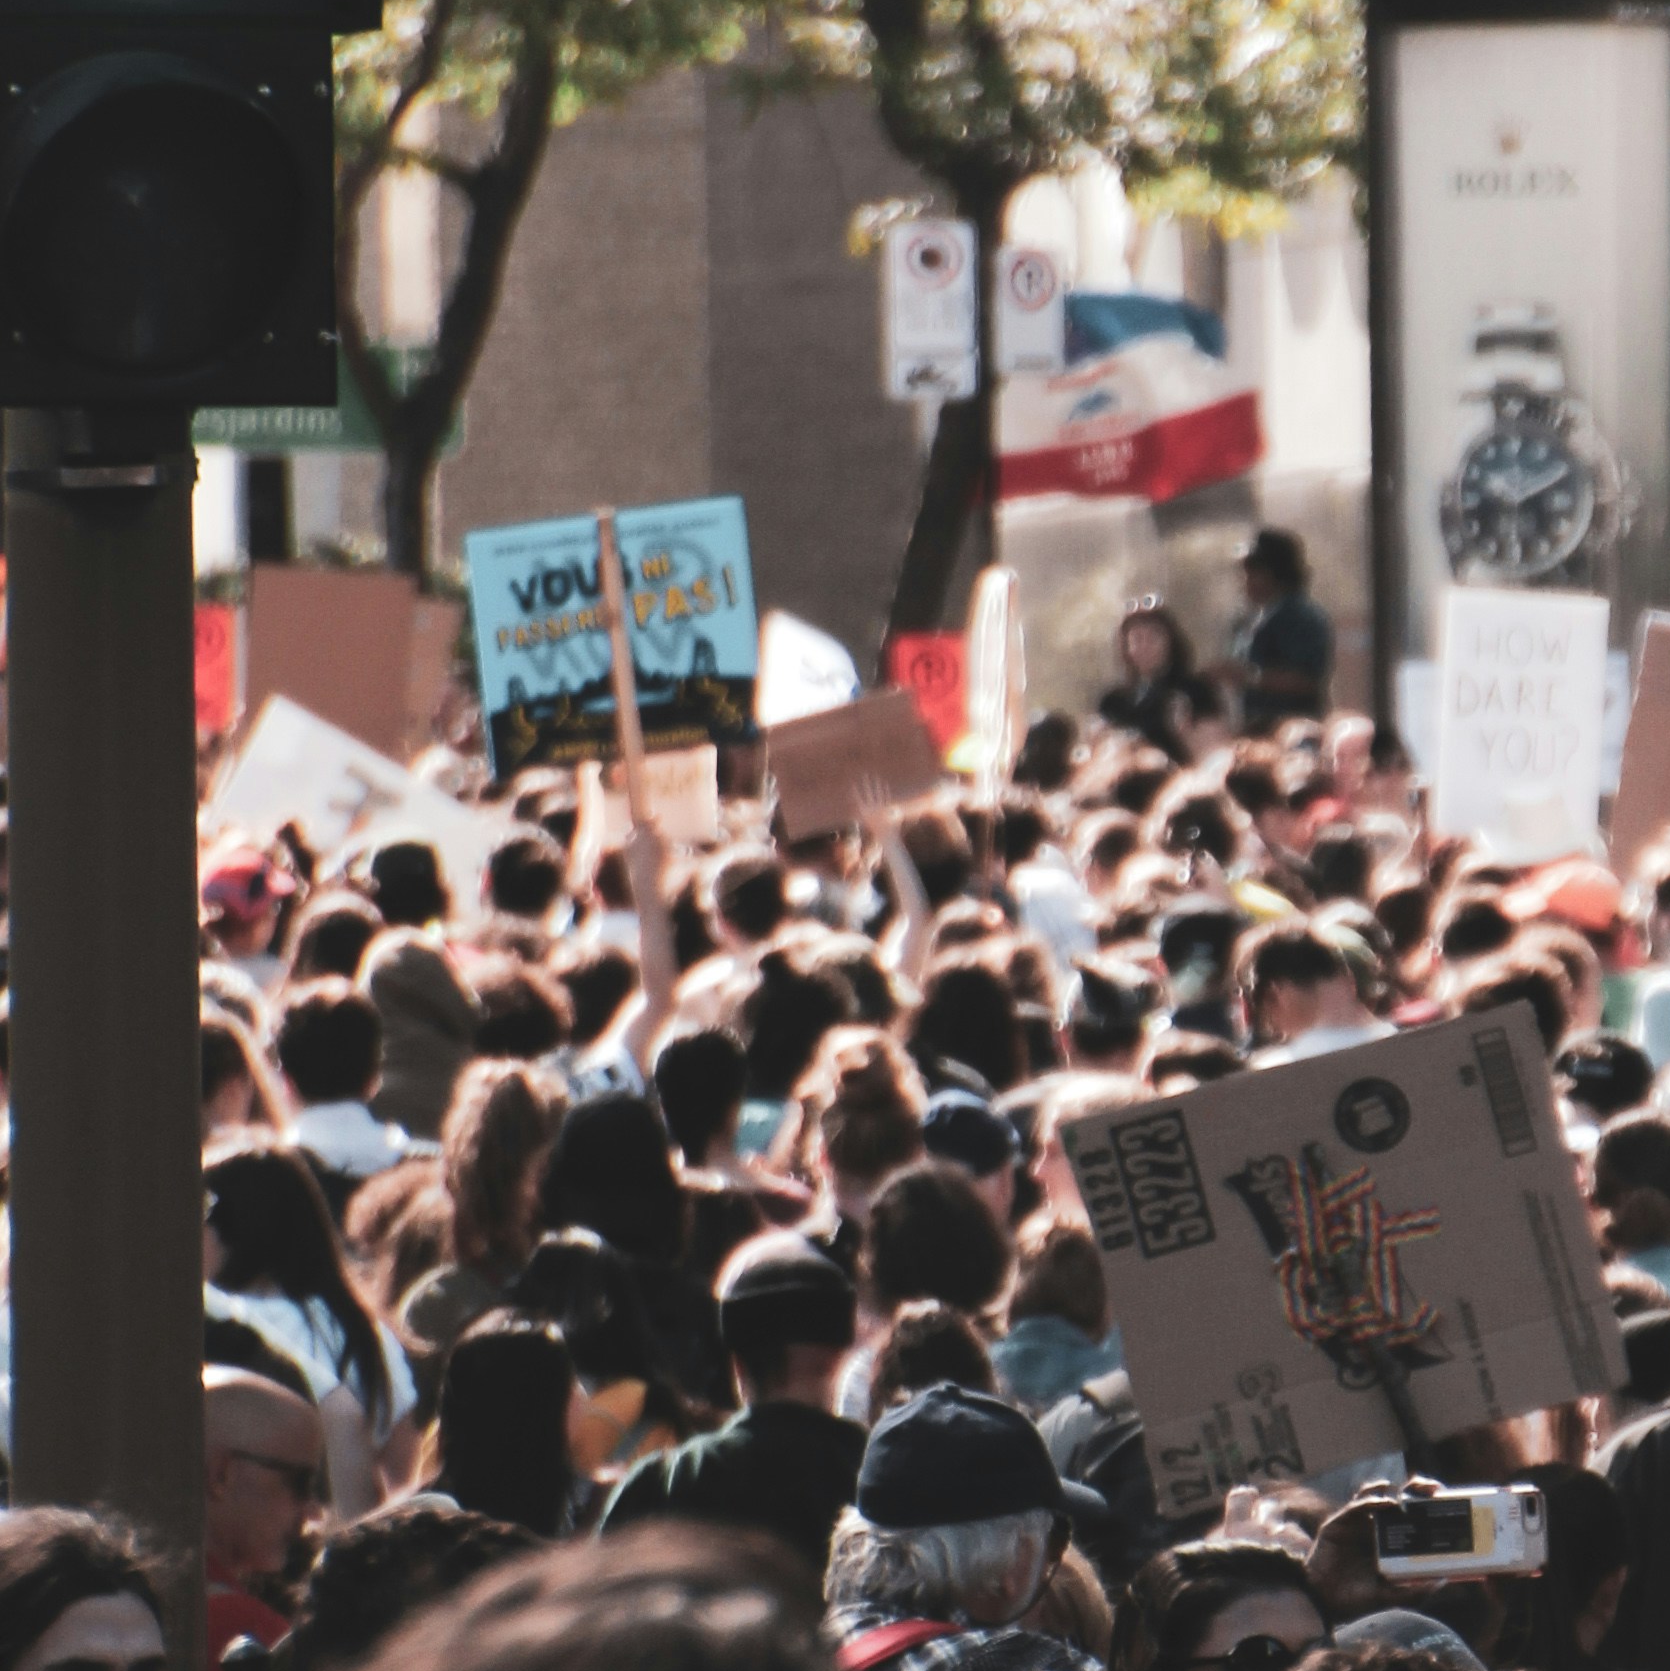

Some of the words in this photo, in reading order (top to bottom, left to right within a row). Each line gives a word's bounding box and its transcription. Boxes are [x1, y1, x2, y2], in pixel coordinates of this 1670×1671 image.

[510, 556, 632, 612] VOU
[1474, 627, 1571, 666] HOW
[1456, 675, 1560, 718] DARE
[1479, 726, 1580, 779] YOU?
[1116, 1114, 1210, 1252] 53223
